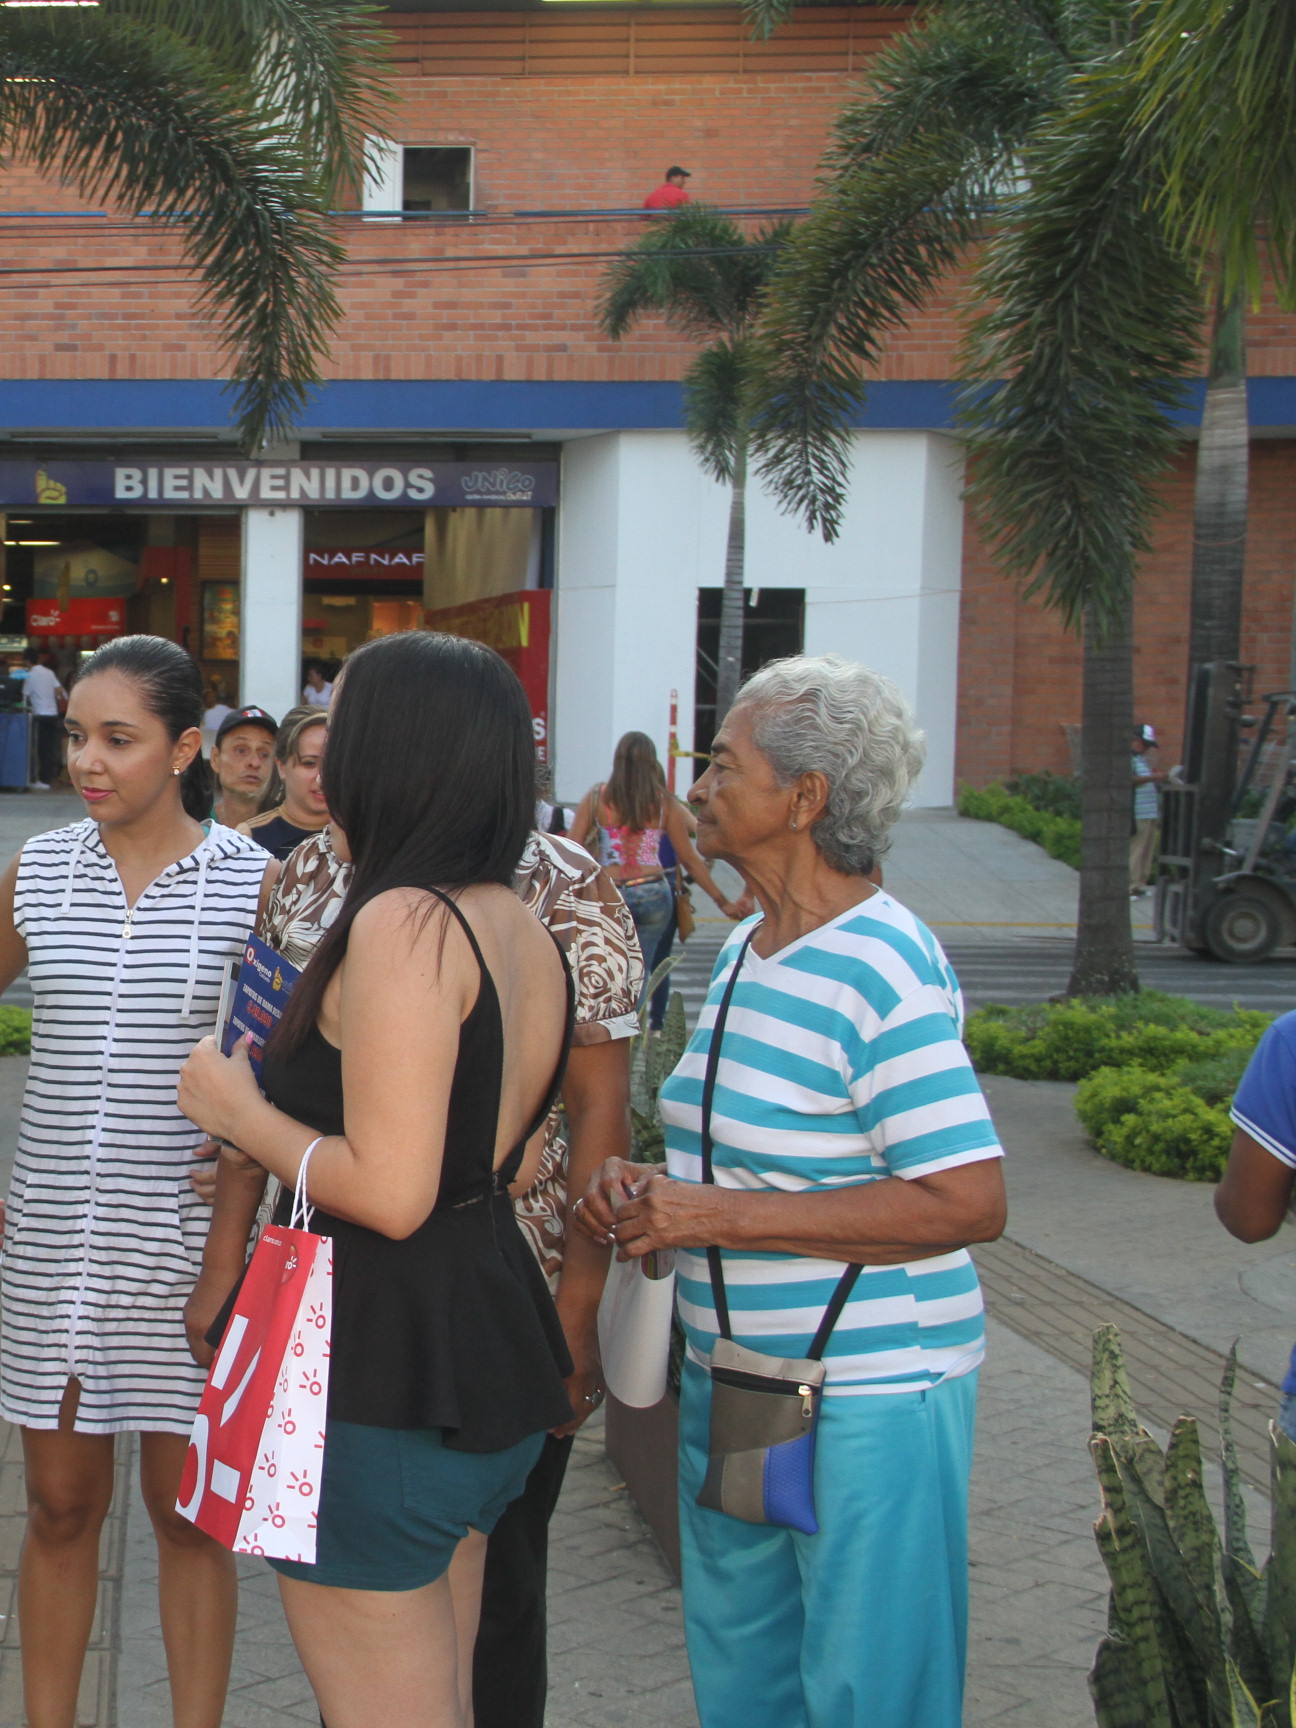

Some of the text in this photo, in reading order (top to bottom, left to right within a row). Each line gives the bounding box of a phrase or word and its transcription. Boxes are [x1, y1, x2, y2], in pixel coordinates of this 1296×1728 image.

[114, 467, 436, 500] BIENVENIDOS
[309, 552, 426, 566] NAF NAF
